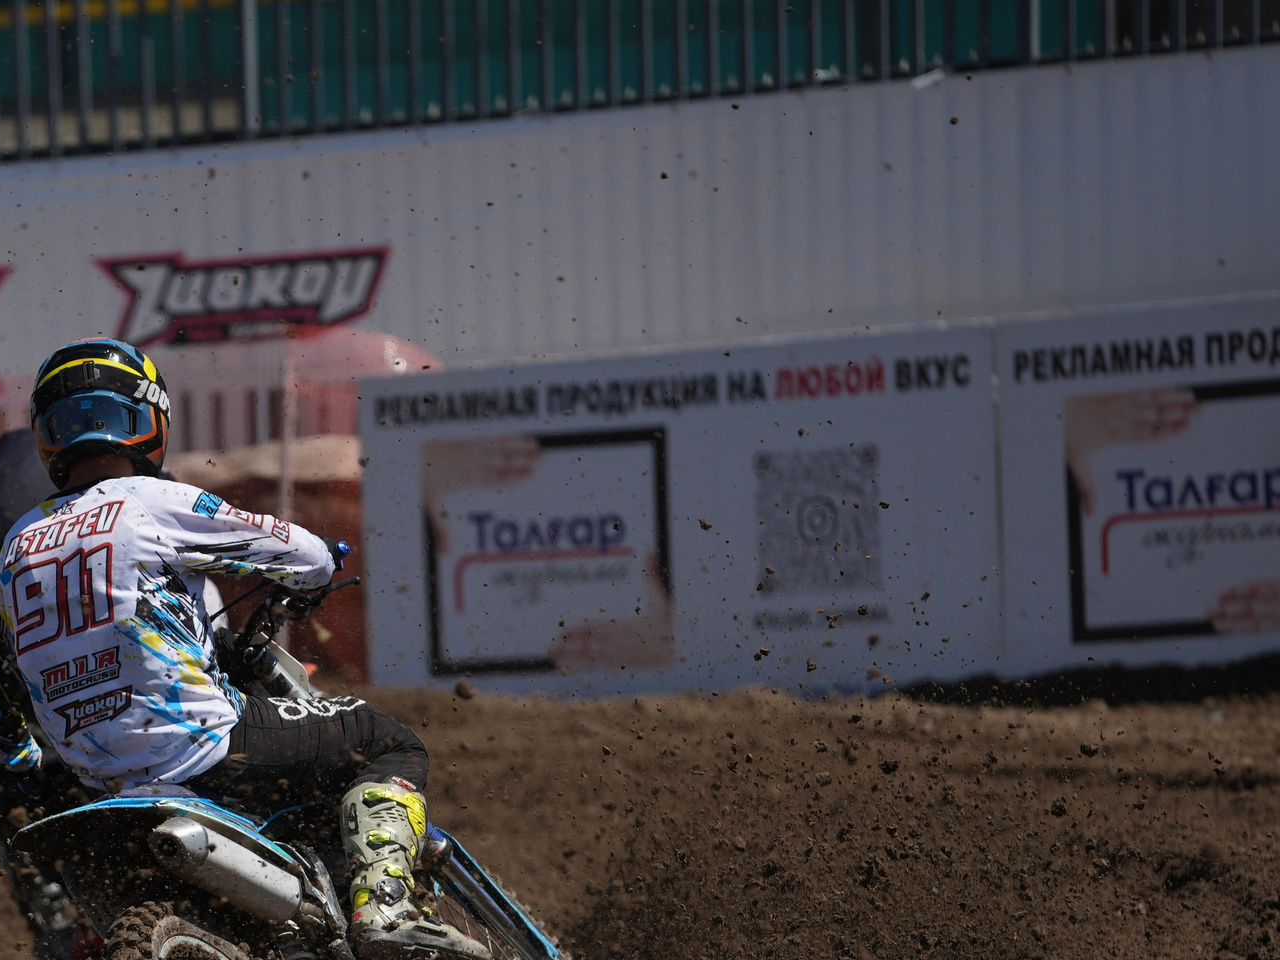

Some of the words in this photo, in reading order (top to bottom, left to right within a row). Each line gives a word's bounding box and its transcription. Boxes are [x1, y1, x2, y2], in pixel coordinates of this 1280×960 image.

[727, 368, 767, 404] НА
[775, 354, 886, 401] ЛЮБОЙ
[893, 353, 971, 392] ВКУС
[1013, 333, 1195, 383] РЕКЛАМНАЯ
[13, 544, 113, 654] 911
[43, 648, 118, 688] MIR
[49, 668, 117, 698] MOTOCROSS
